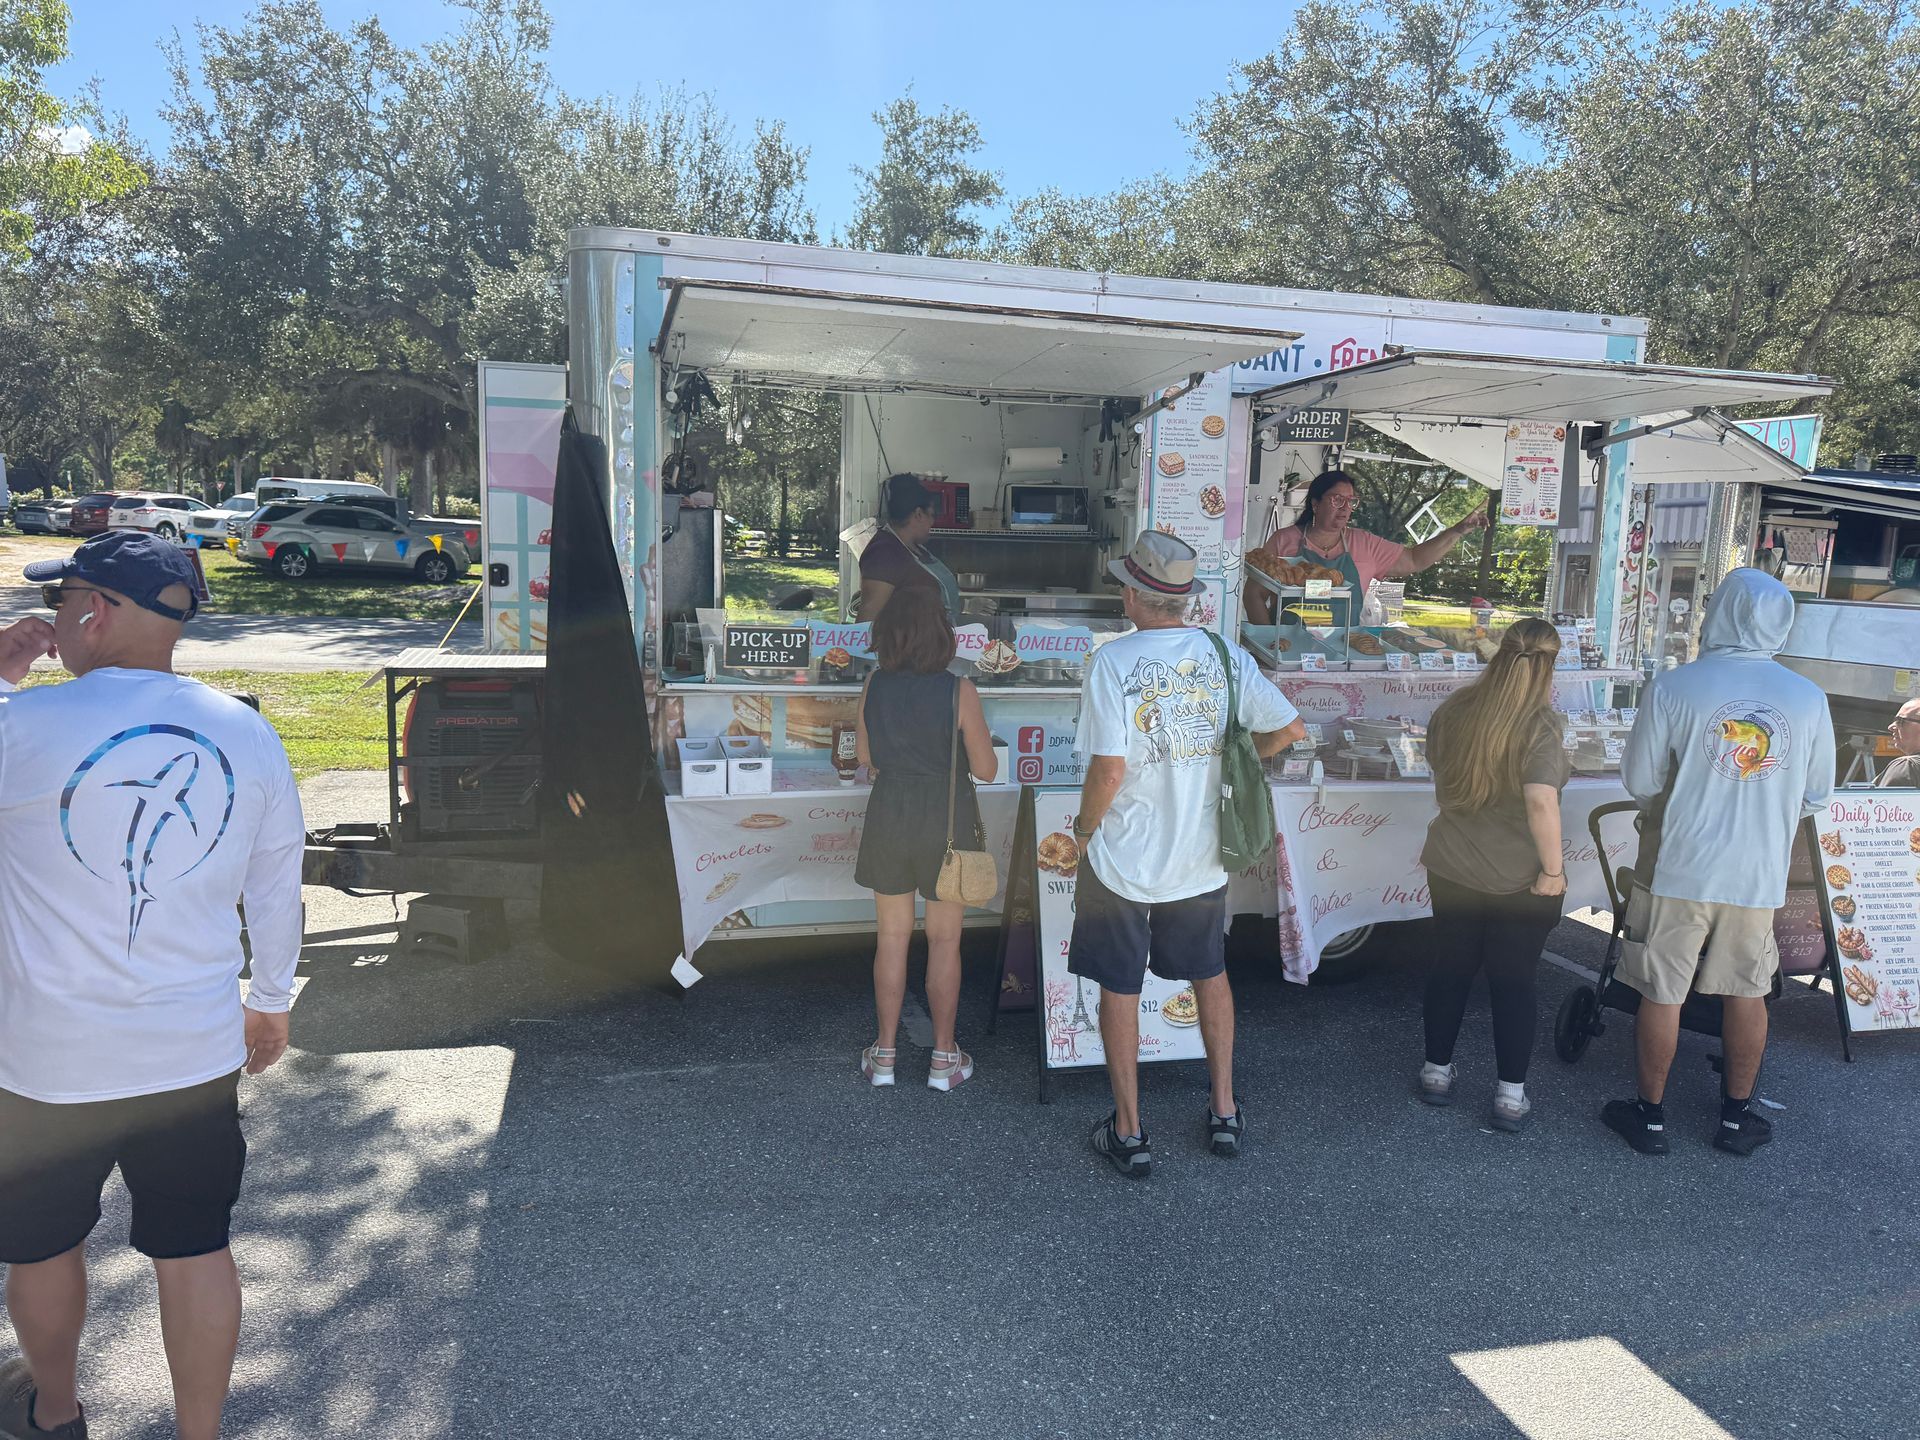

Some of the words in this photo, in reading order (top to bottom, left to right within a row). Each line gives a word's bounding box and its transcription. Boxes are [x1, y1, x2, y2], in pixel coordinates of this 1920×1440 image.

[1295, 428, 1330, 439] HERE
[730, 631, 807, 648] PICK-UP
[1018, 635, 1090, 651] OMELETS
[748, 651, 789, 663] HERE
[1295, 698, 1317, 710] Daily
[1727, 702, 1745, 711] BAIT
[435, 717, 519, 725] PREDATOR
[1780, 721, 1788, 740] BAIT
[1298, 802, 1393, 837] Bakery
[1830, 802, 1871, 828] Daily
[1873, 804, 1915, 823] Délice
[1064, 815, 1073, 829] 2
[1855, 826, 1875, 835] Bakery
[1881, 826, 1897, 834] Bistro
[1316, 848, 1340, 871] &
[1060, 940, 1069, 955] 2
[1791, 946, 1813, 956] $13
[1141, 1000, 1158, 1013] $12
